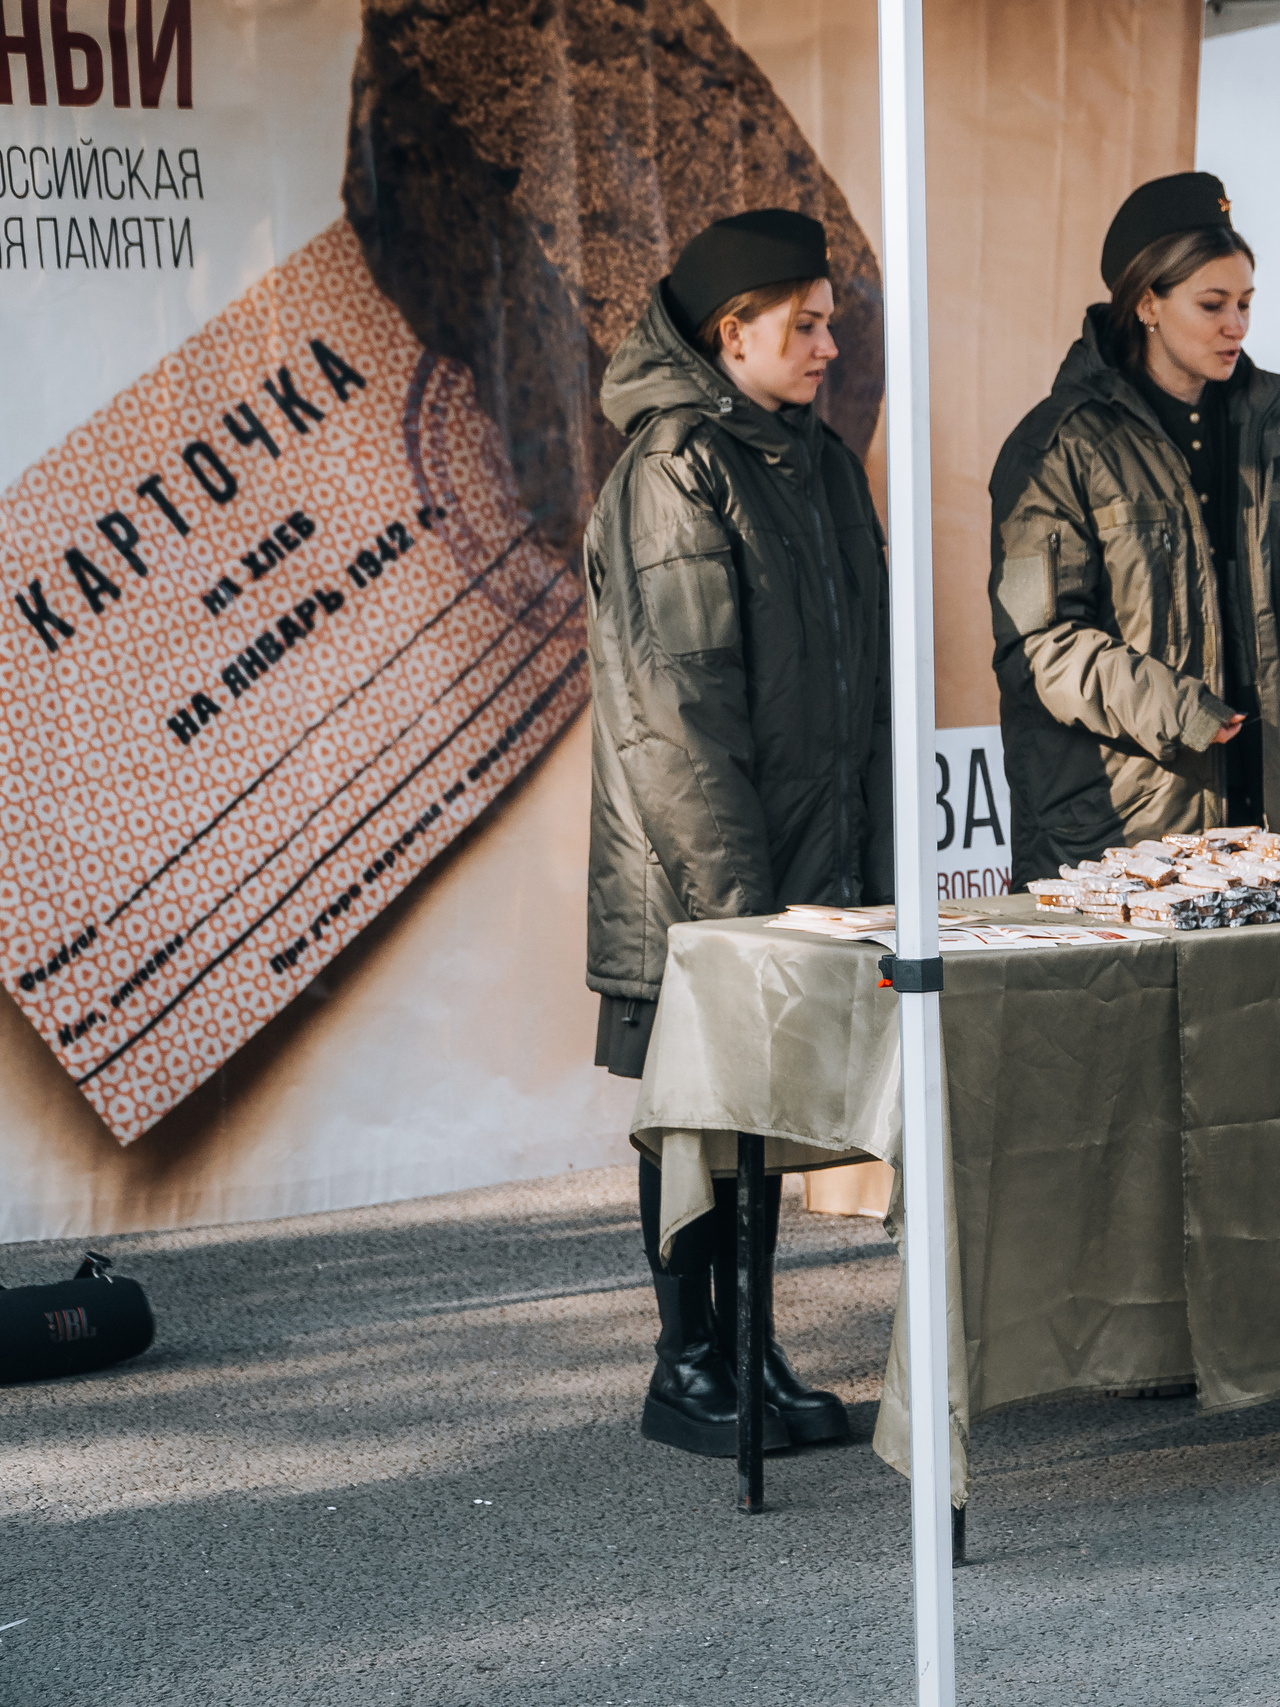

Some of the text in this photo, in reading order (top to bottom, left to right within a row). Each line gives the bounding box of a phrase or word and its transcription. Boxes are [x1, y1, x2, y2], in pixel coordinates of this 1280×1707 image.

[0, 137, 204, 200] ССИЙСКАЯ
[0, 216, 194, 269] Я ПАМЯТИ
[15, 338, 367, 652] КАРТОЧКА
[240, 511, 316, 581] ХЛЕБ
[167, 692, 221, 745] НА
[221, 589, 345, 698] ЯНВАРЬ
[346, 521, 415, 589] 1942
[48, 1307, 97, 1341] JBL
